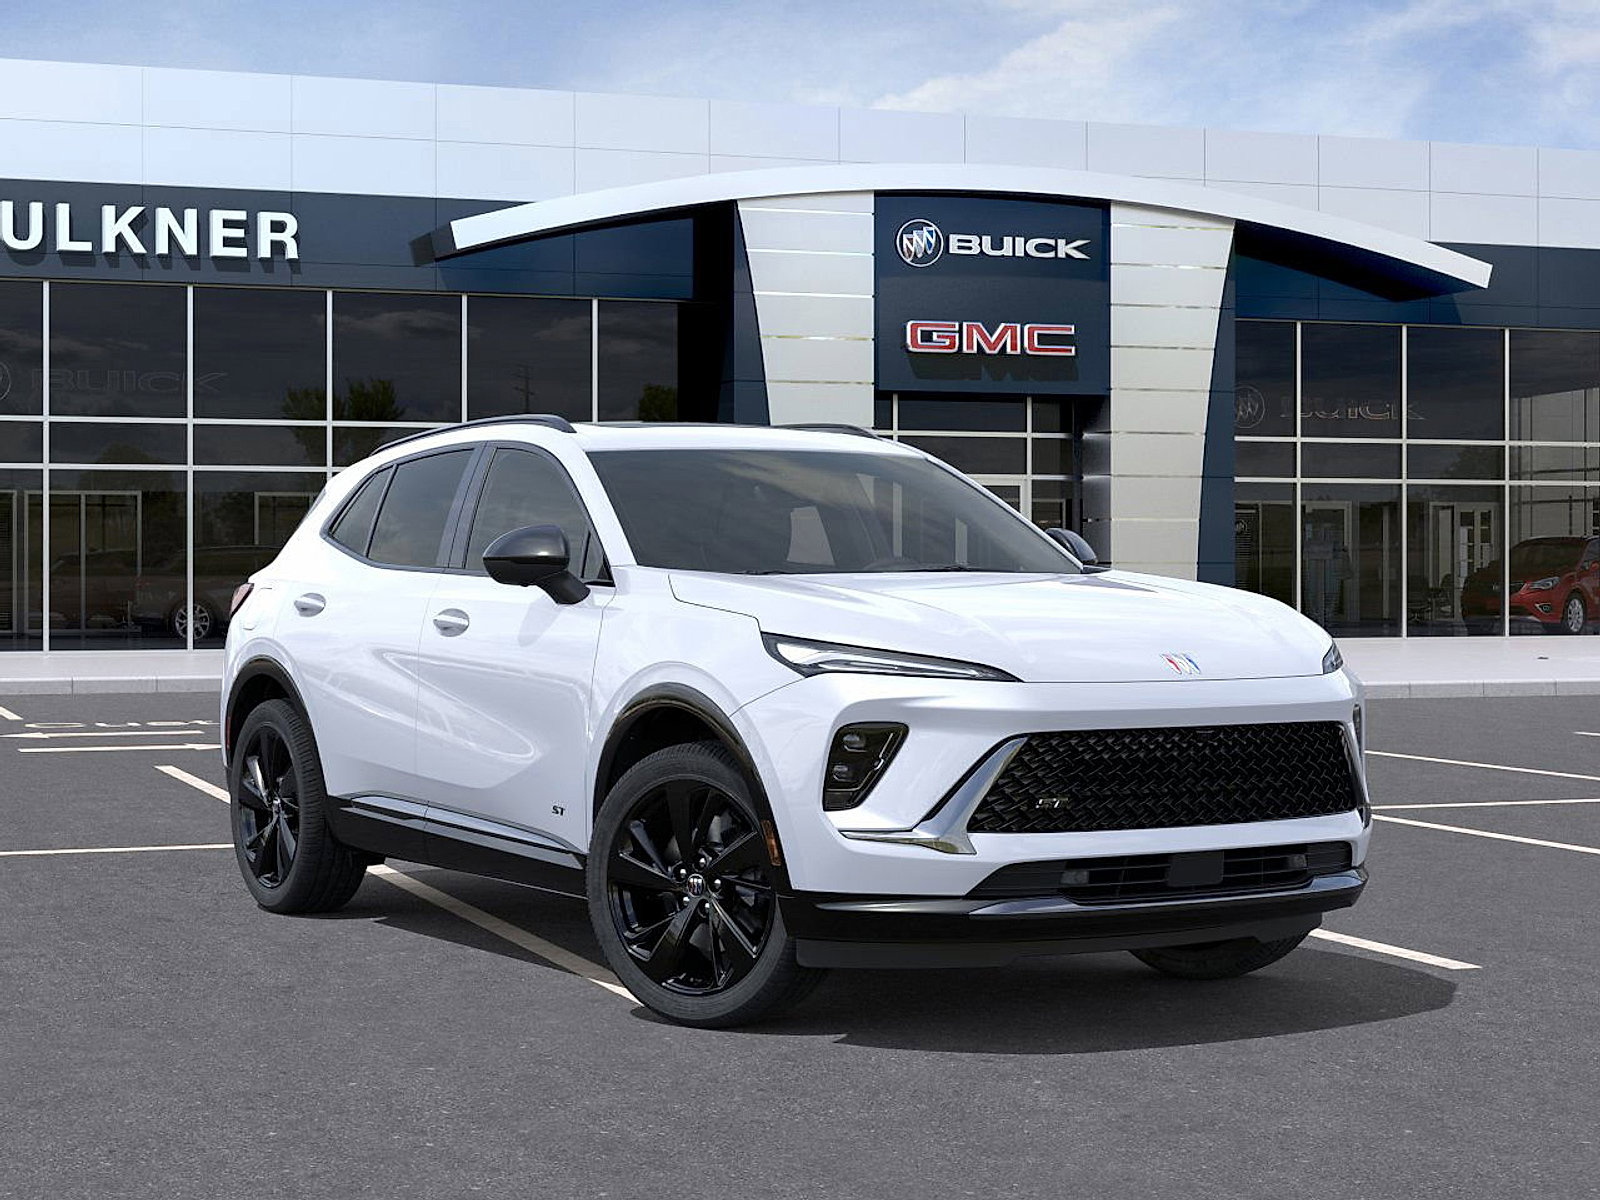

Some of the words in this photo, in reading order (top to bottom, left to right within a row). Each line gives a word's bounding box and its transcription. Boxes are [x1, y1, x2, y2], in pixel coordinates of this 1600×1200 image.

[949, 233, 1092, 260] BUICK
[906, 320, 1076, 356] GMC
[551, 805, 566, 816] ST
